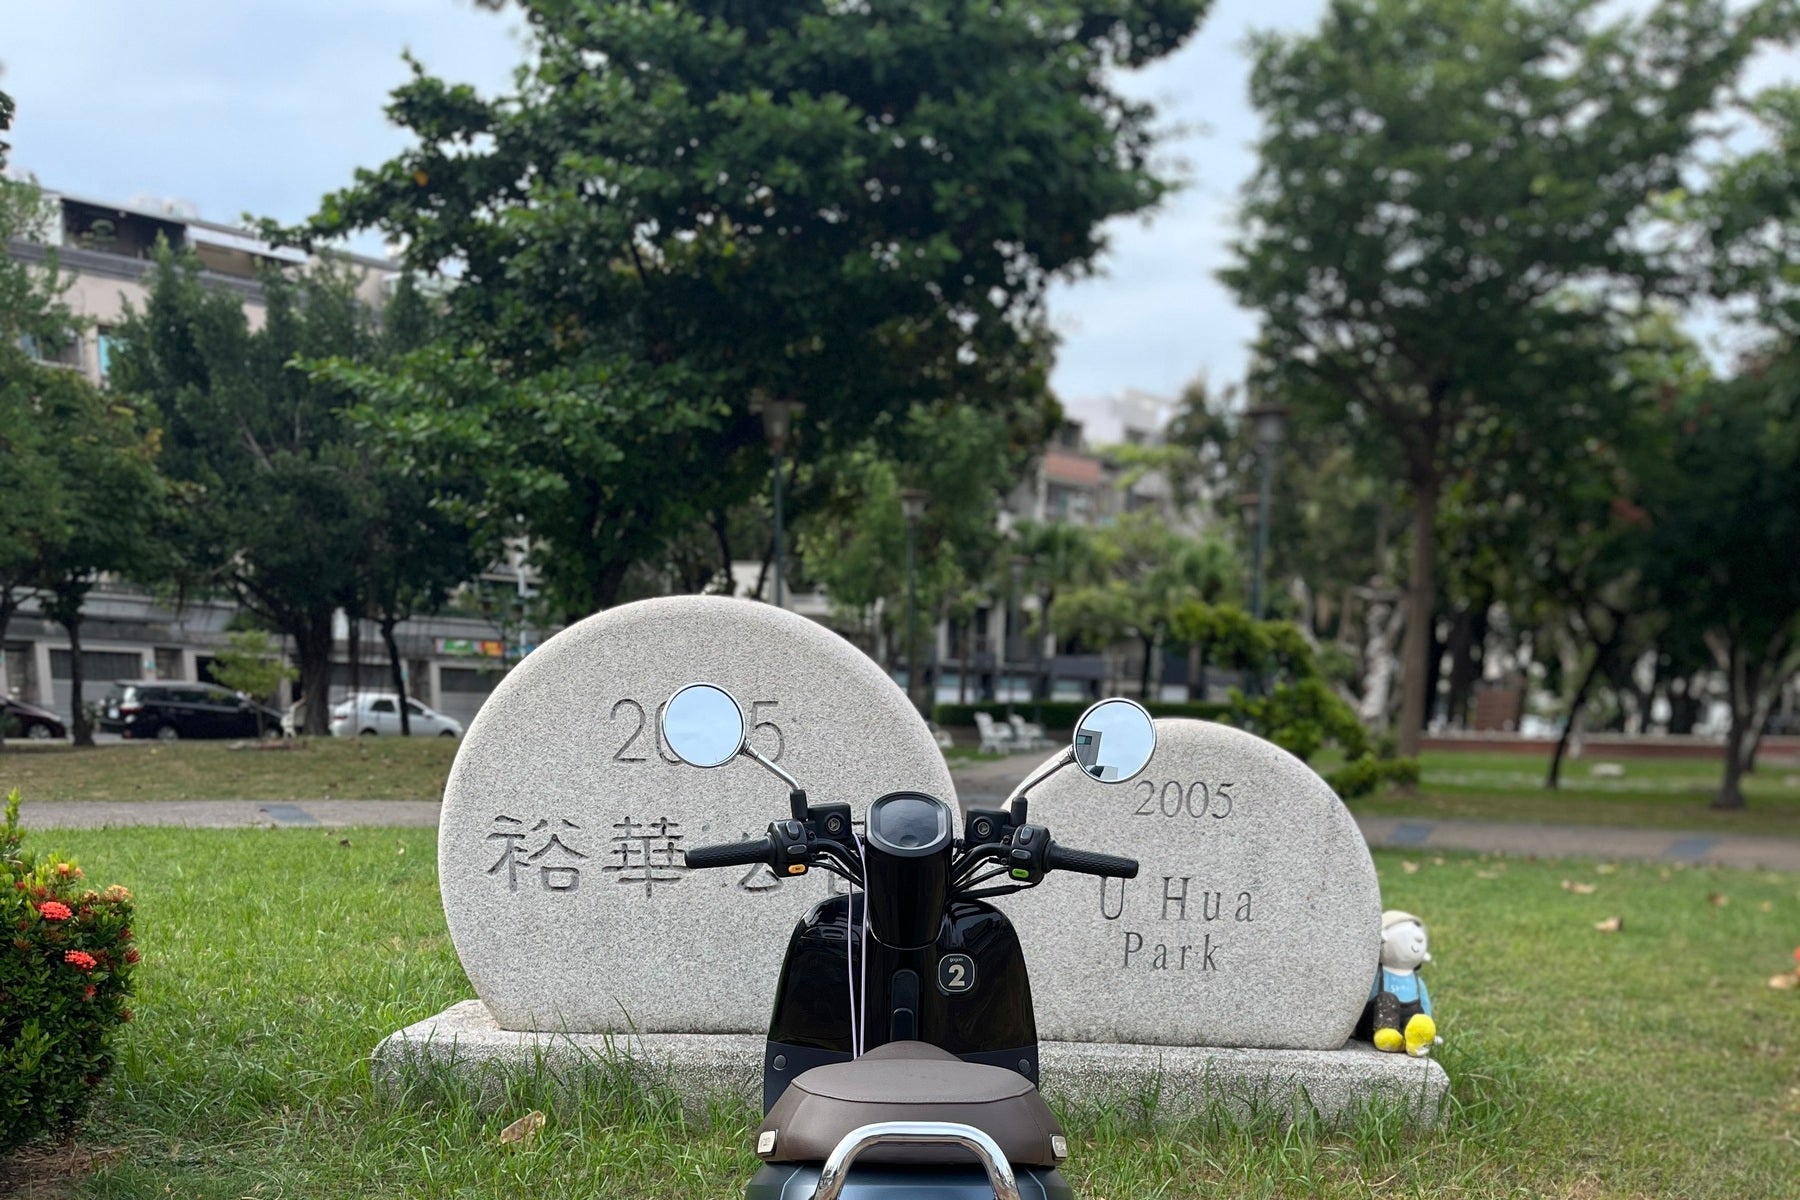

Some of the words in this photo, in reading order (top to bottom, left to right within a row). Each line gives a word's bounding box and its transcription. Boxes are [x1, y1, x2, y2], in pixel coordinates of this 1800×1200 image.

[609, 698, 785, 767] 25
[1134, 780, 1235, 820] 2005
[485, 814, 867, 900] 裕華
[1099, 875, 1128, 921] U
[1160, 876, 1255, 923] Hua
[1123, 931, 1224, 972] Park
[948, 964, 966, 987] 2
